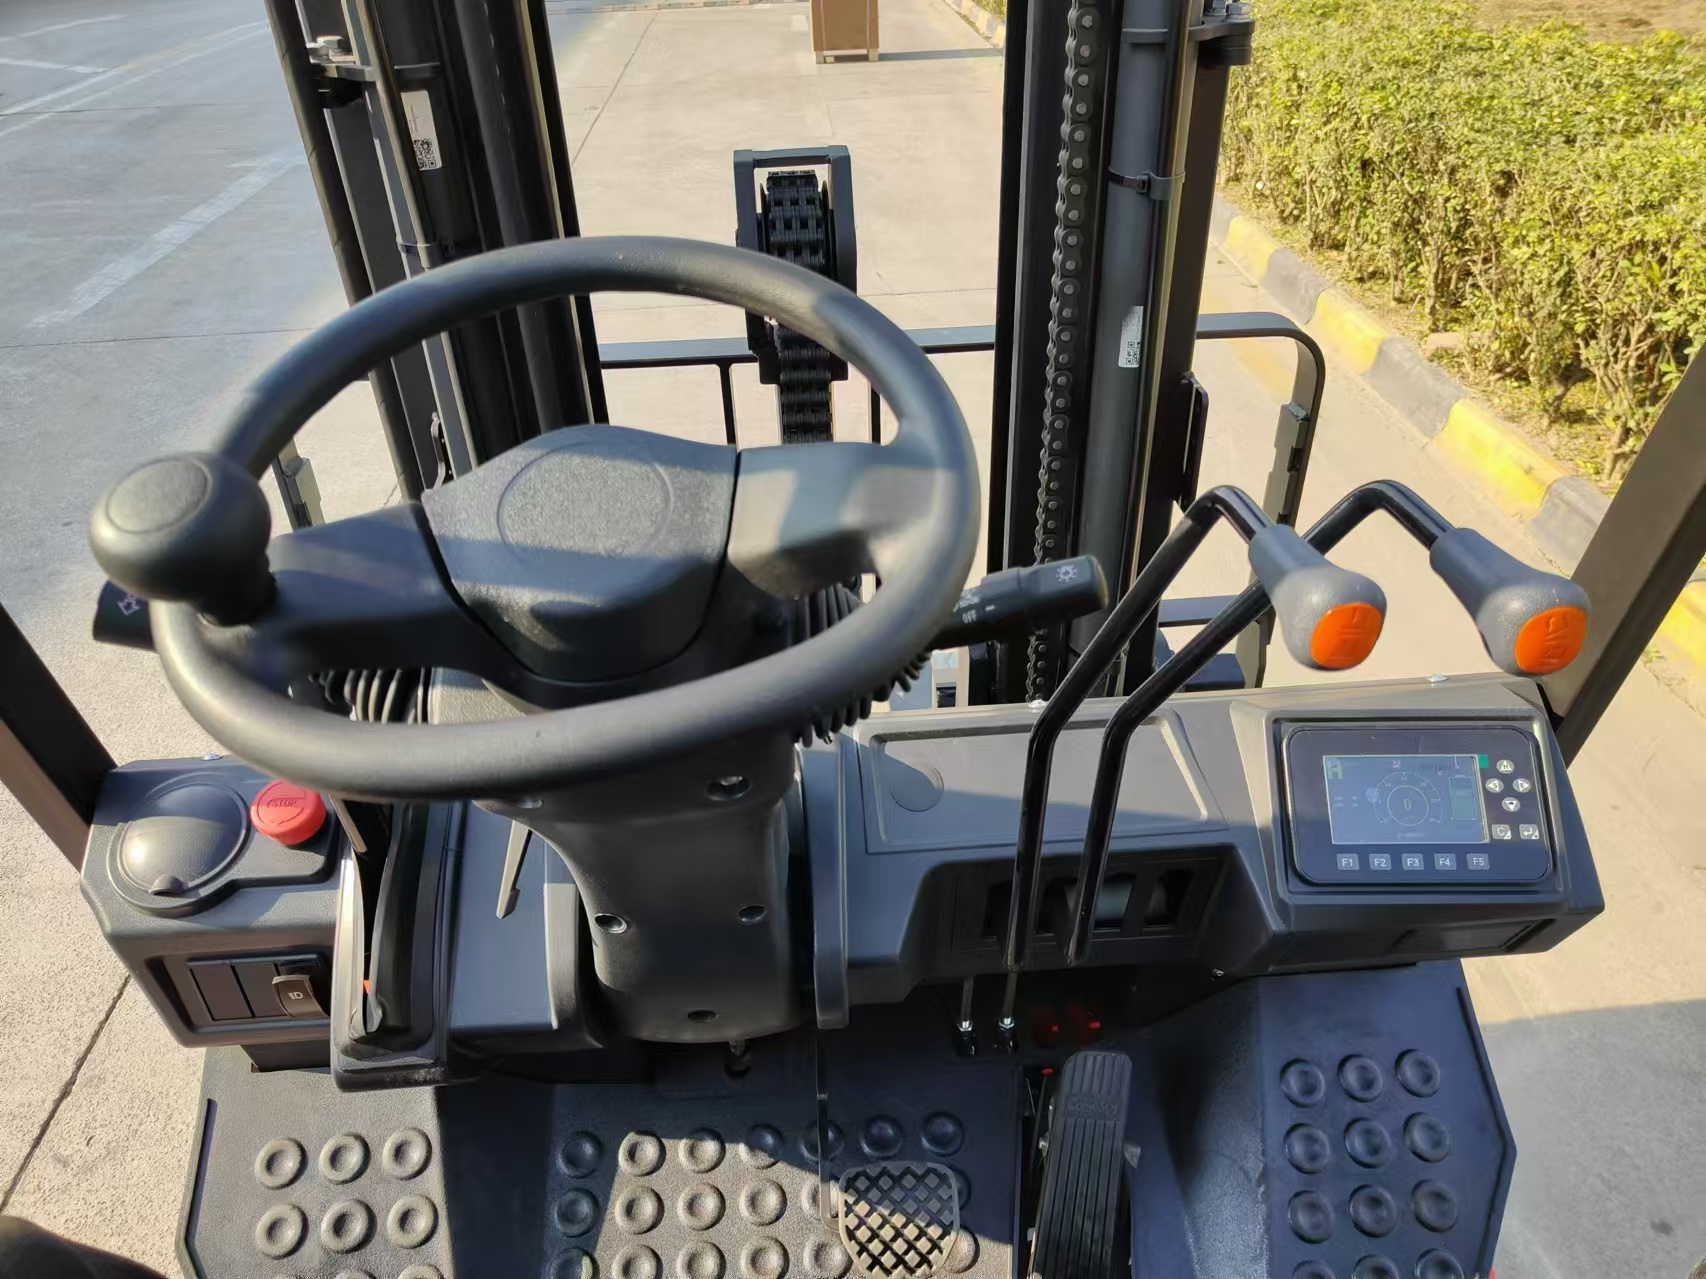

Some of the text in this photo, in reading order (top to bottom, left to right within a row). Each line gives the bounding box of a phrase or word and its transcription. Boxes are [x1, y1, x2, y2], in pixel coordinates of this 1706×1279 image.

[271, 799, 297, 808] STOP
[1497, 827, 1505, 836] C
[1341, 858, 1353, 867] F1
[1374, 858, 1387, 867] F2
[1407, 858, 1420, 867] F3
[1439, 858, 1451, 867] F4
[1472, 857, 1485, 866] F5
